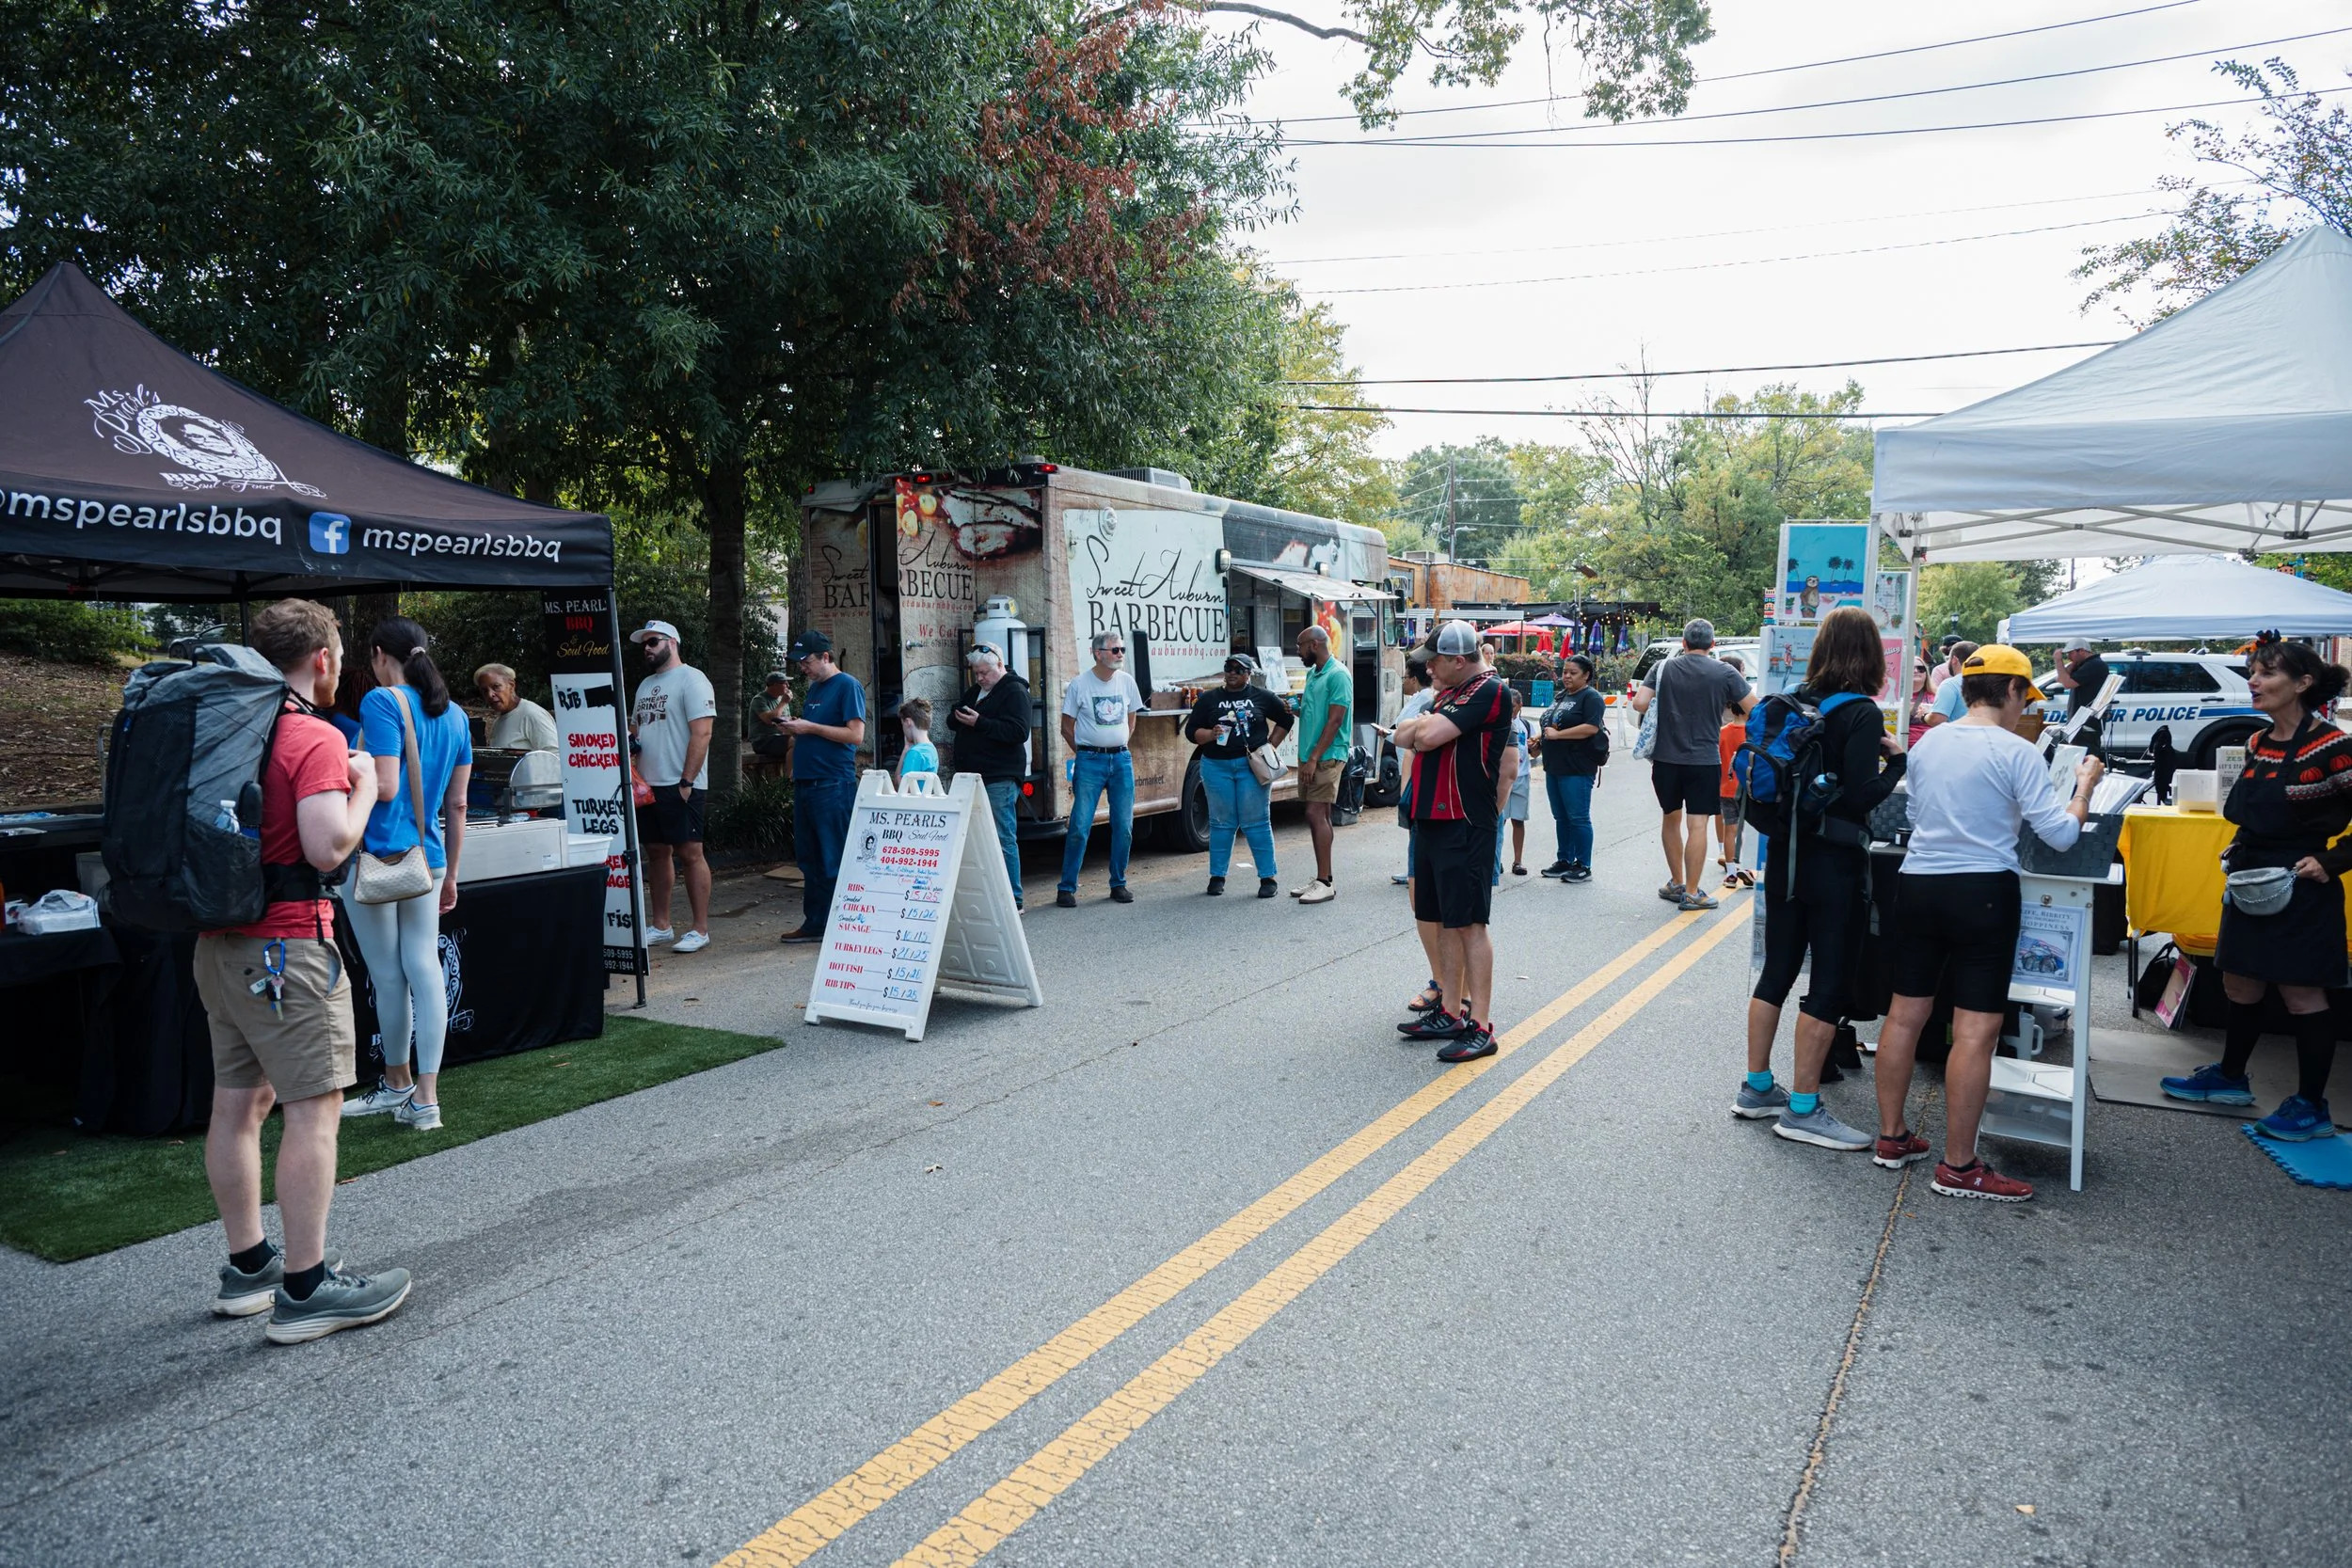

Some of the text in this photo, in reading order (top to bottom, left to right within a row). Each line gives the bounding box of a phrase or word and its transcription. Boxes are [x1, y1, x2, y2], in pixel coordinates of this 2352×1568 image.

[159, 472, 219, 482] BBQ
[362, 527, 563, 562] mspearlsbbq
[1086, 534, 1224, 604] Sweet Auburn
[544, 601, 564, 614] MS.
[565, 615, 595, 634] BBQ
[1087, 600, 1226, 643] BARBECUE
[918, 624, 933, 638] We
[556, 640, 610, 658] Soul Food
[2132, 705, 2200, 722] POLICE
[567, 732, 616, 751] SMOKED
[571, 797, 625, 819] TURKEY
[581, 817, 620, 835] LEGS
[868, 811, 947, 828] MS. PEARLS
[882, 829, 903, 843] BBQ
[908, 829, 929, 841] Soul
[882, 846, 940, 857] 678-509-5995
[880, 855, 938, 868] 404-992-1944
[847, 882, 866, 893] RIBS
[843, 903, 876, 913] CHICKEN
[837, 922, 872, 934] SAUSAGE
[602, 947, 633, 959] 509-5995
[834, 942, 863, 953] TURKEY
[863, 945, 882, 956] LEGS
[603, 959, 634, 971] 992-1944
[829, 960, 845, 972] HOT
[845, 963, 864, 974] FISH
[824, 978, 838, 988] RIB
[838, 980, 856, 990] TIPS
